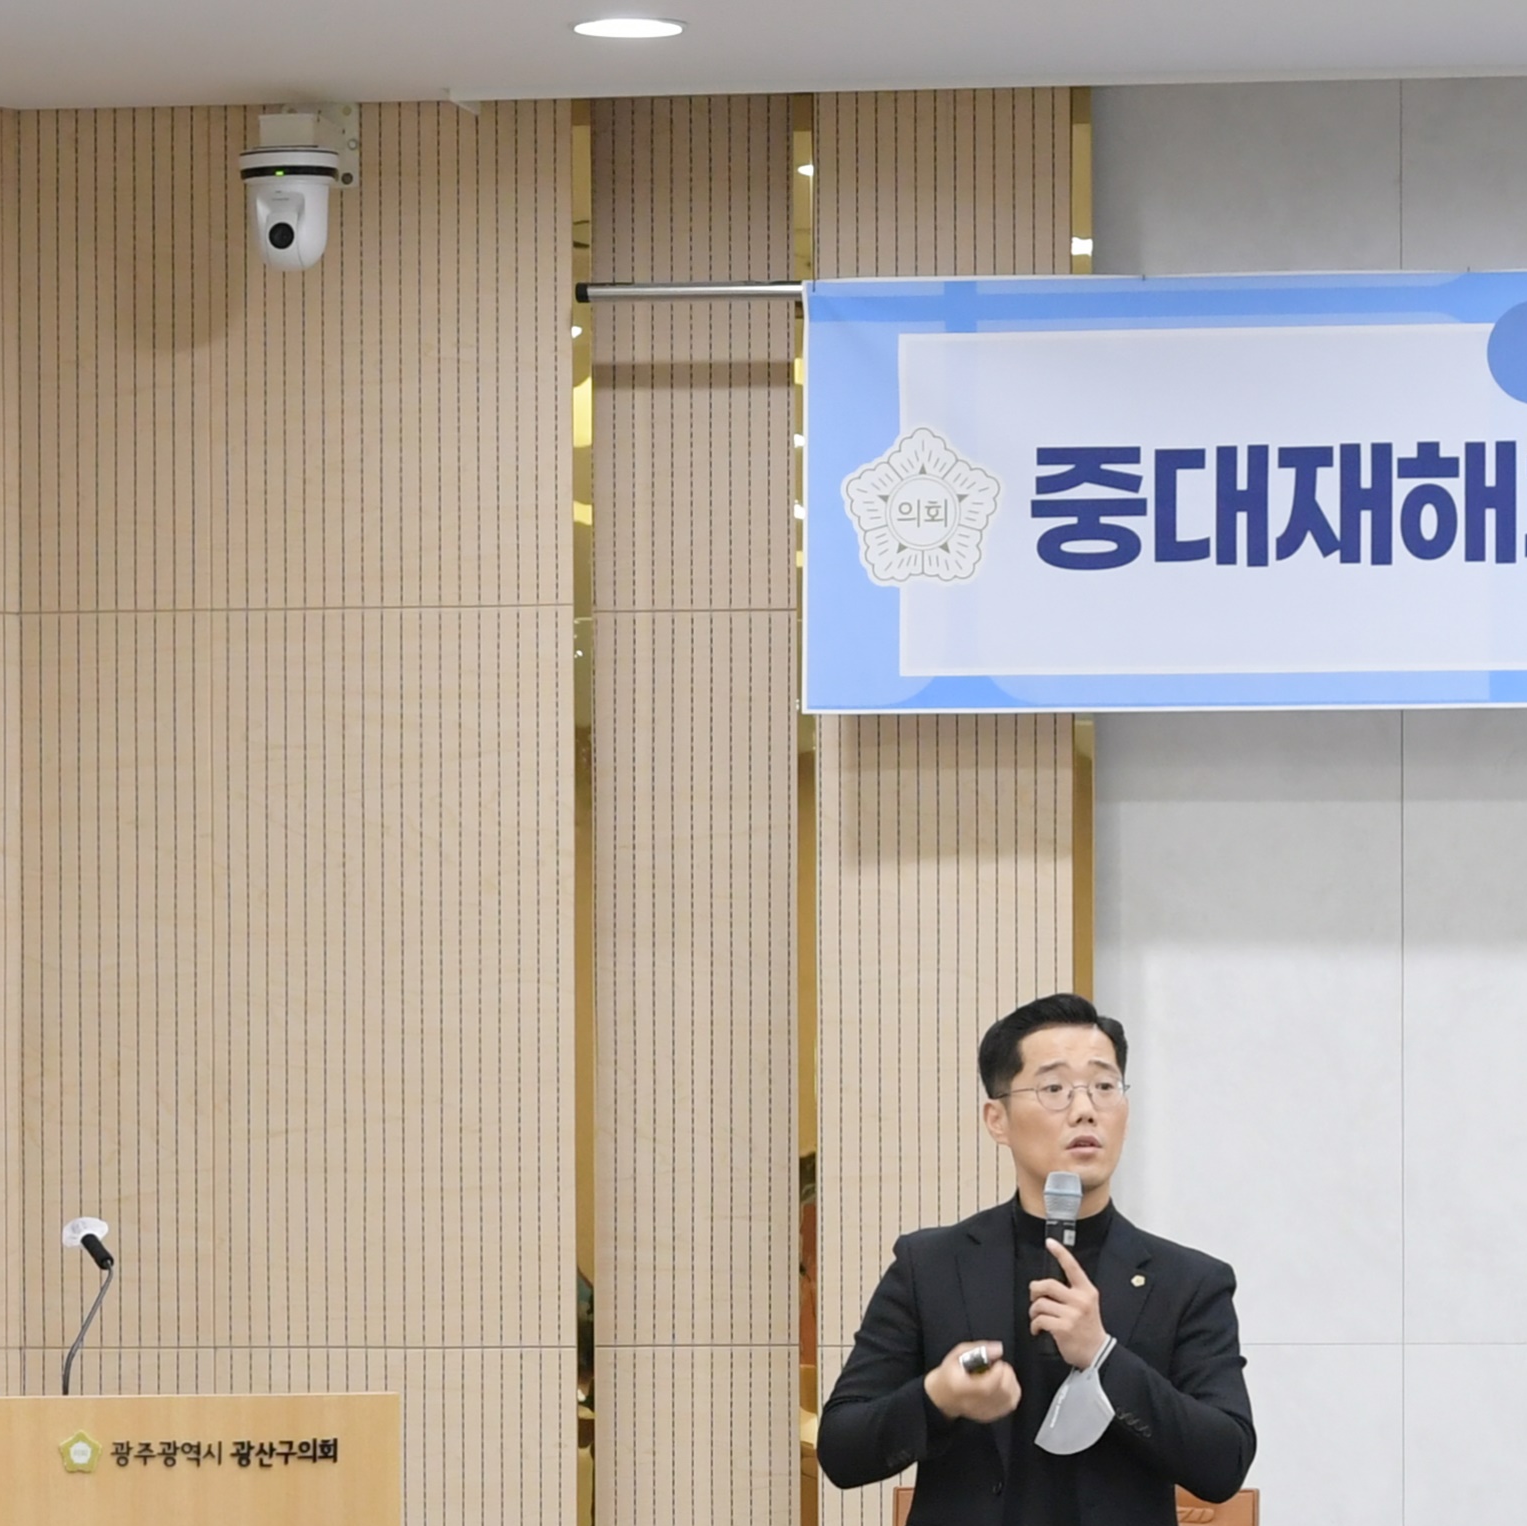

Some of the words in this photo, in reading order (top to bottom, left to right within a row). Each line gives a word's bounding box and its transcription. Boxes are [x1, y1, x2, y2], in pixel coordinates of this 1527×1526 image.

[896, 498, 948, 529] 의회
[110, 1440, 223, 1469] 광주광역시
[230, 1438, 339, 1469] 광산구의회
